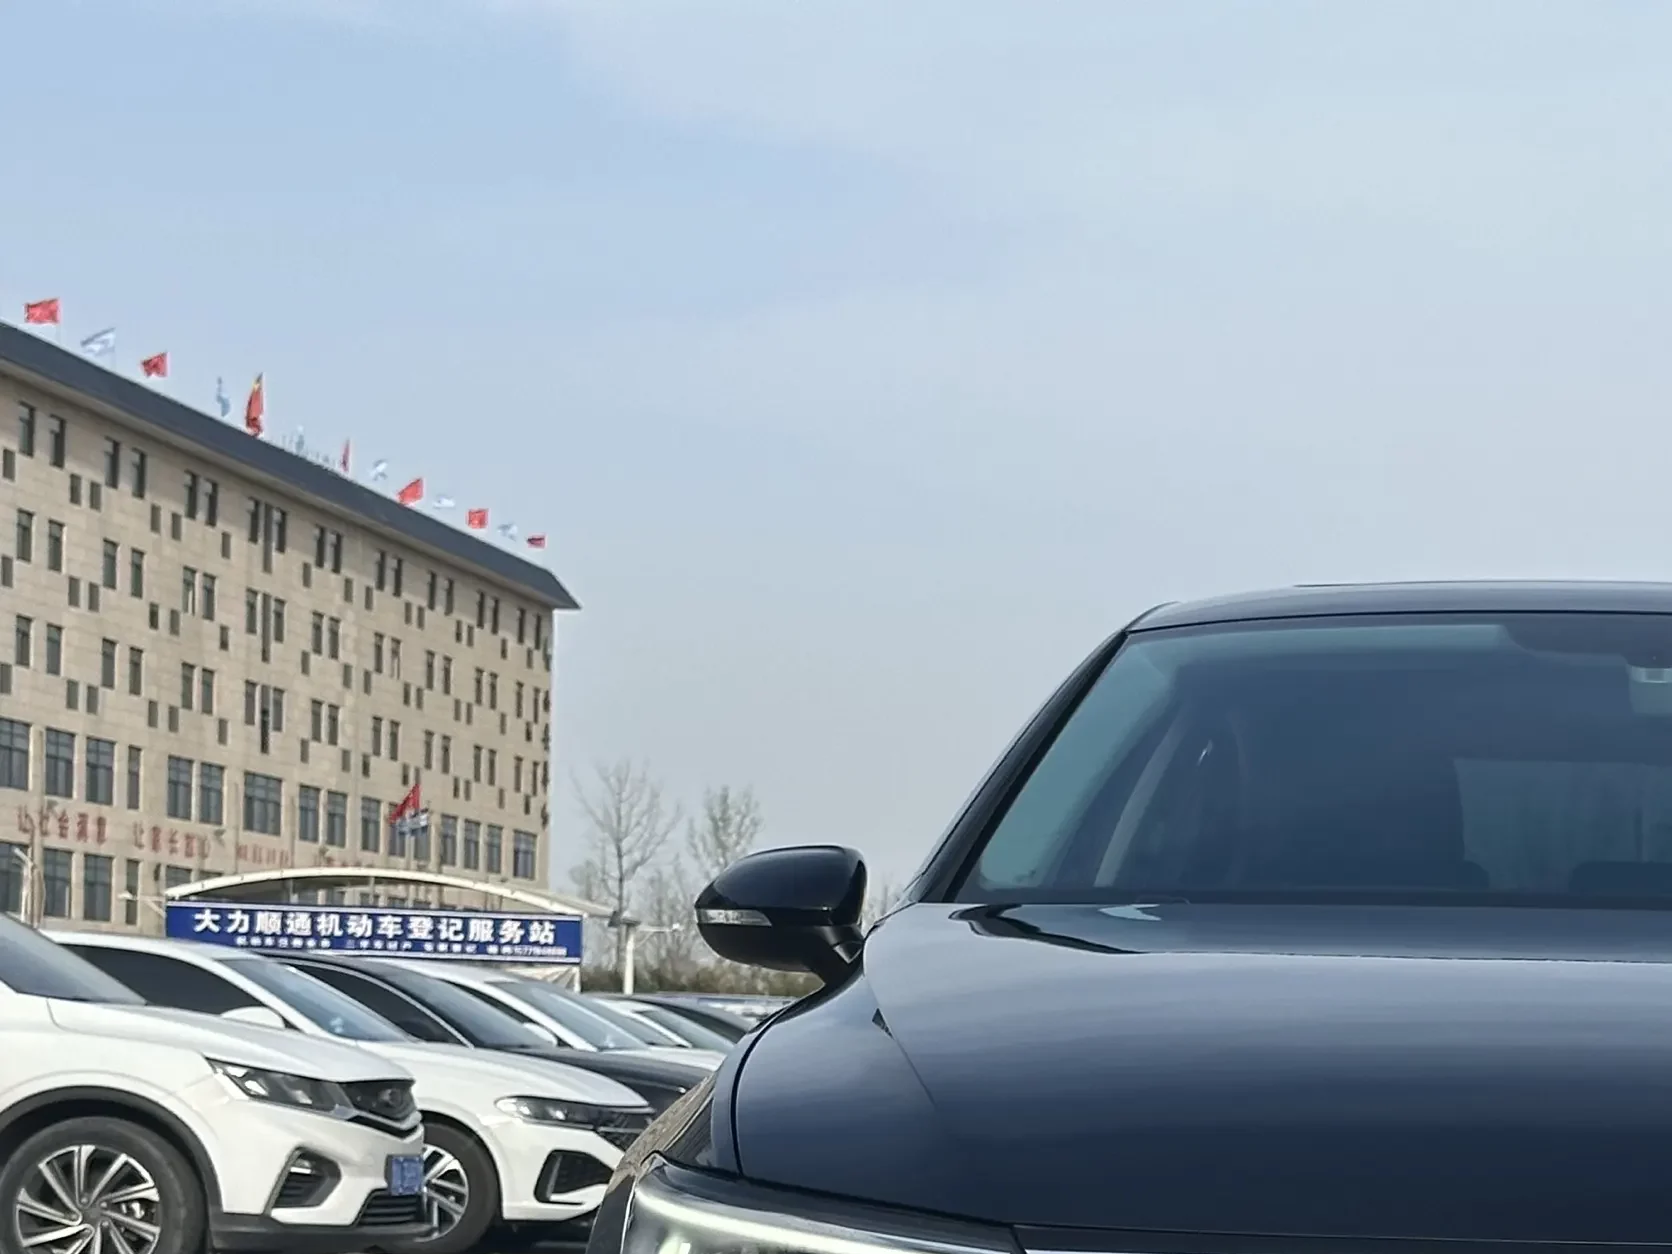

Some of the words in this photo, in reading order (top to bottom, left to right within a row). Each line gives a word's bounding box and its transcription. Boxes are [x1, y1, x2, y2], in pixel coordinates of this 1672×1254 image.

[194, 908, 556, 945] 大力顺通机动车登记服务站
